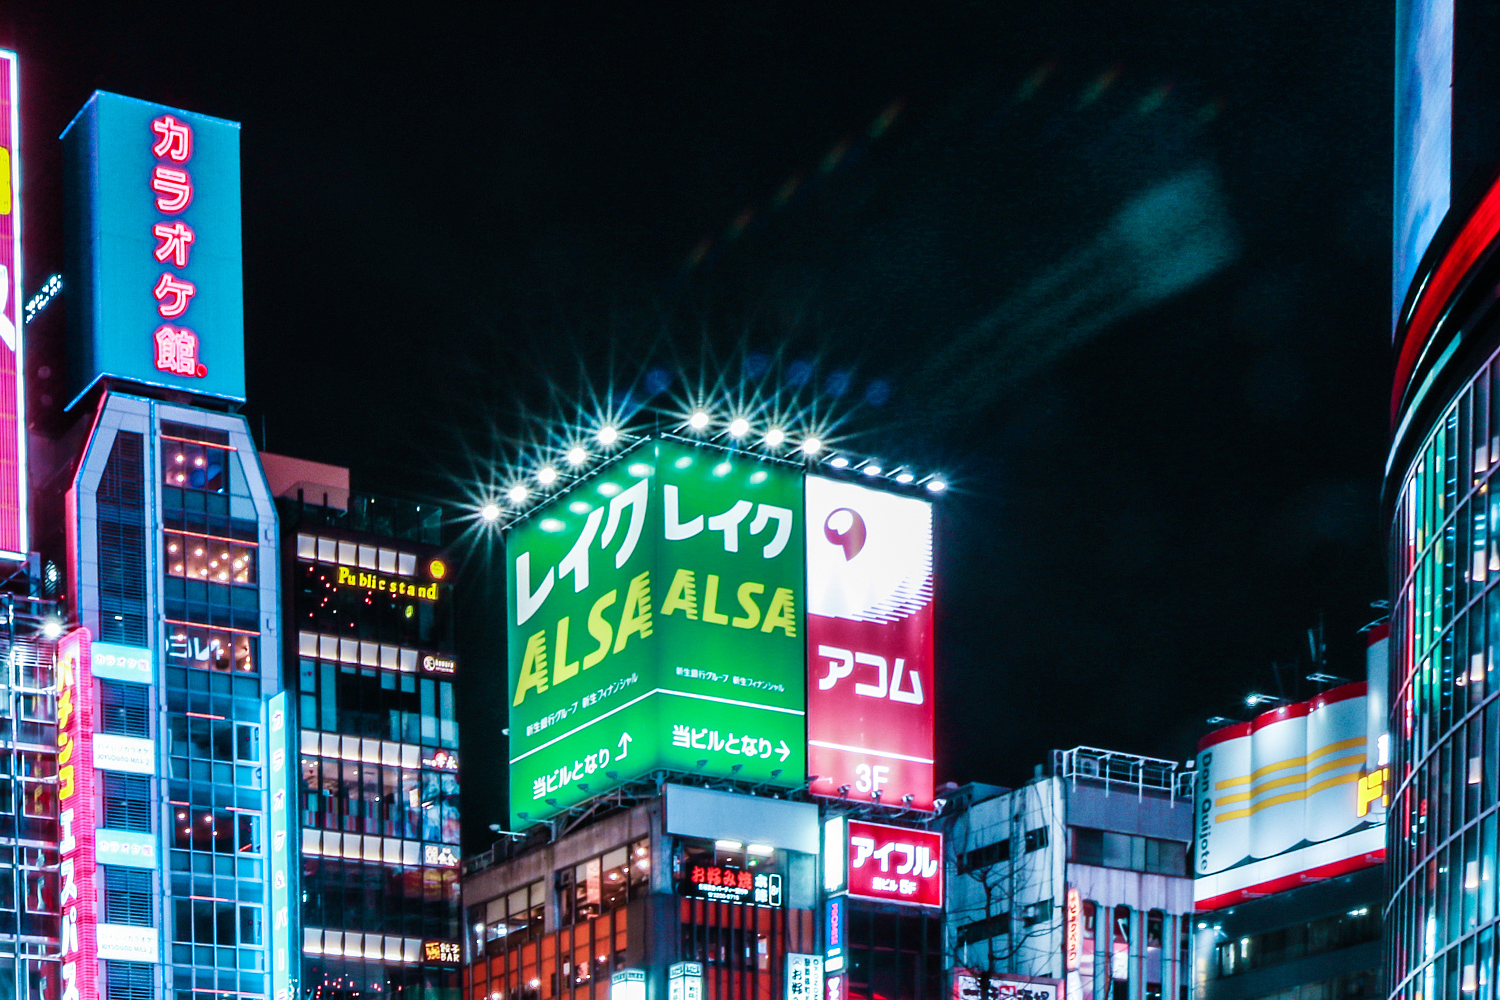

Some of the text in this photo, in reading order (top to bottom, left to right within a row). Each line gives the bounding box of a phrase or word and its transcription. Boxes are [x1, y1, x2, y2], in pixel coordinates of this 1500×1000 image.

[151, 115, 198, 378] カラオケ館
[663, 485, 793, 559] レイク
[516, 477, 649, 626] レイク
[339, 566, 438, 600] Public stand
[660, 569, 796, 637] ALSA
[513, 571, 653, 707] ALSA
[818, 645, 924, 705] アコム
[671, 724, 772, 759] 当ビルとなり
[532, 747, 610, 800] 当ビルとなり
[855, 763, 889, 793] 3F
[1200, 753, 1212, 871] Don Quijote
[691, 866, 752, 890] お好み焼
[851, 836, 937, 878] アイフル
[830, 903, 838, 945] PROMISE
[440, 953, 460, 962] BAR
